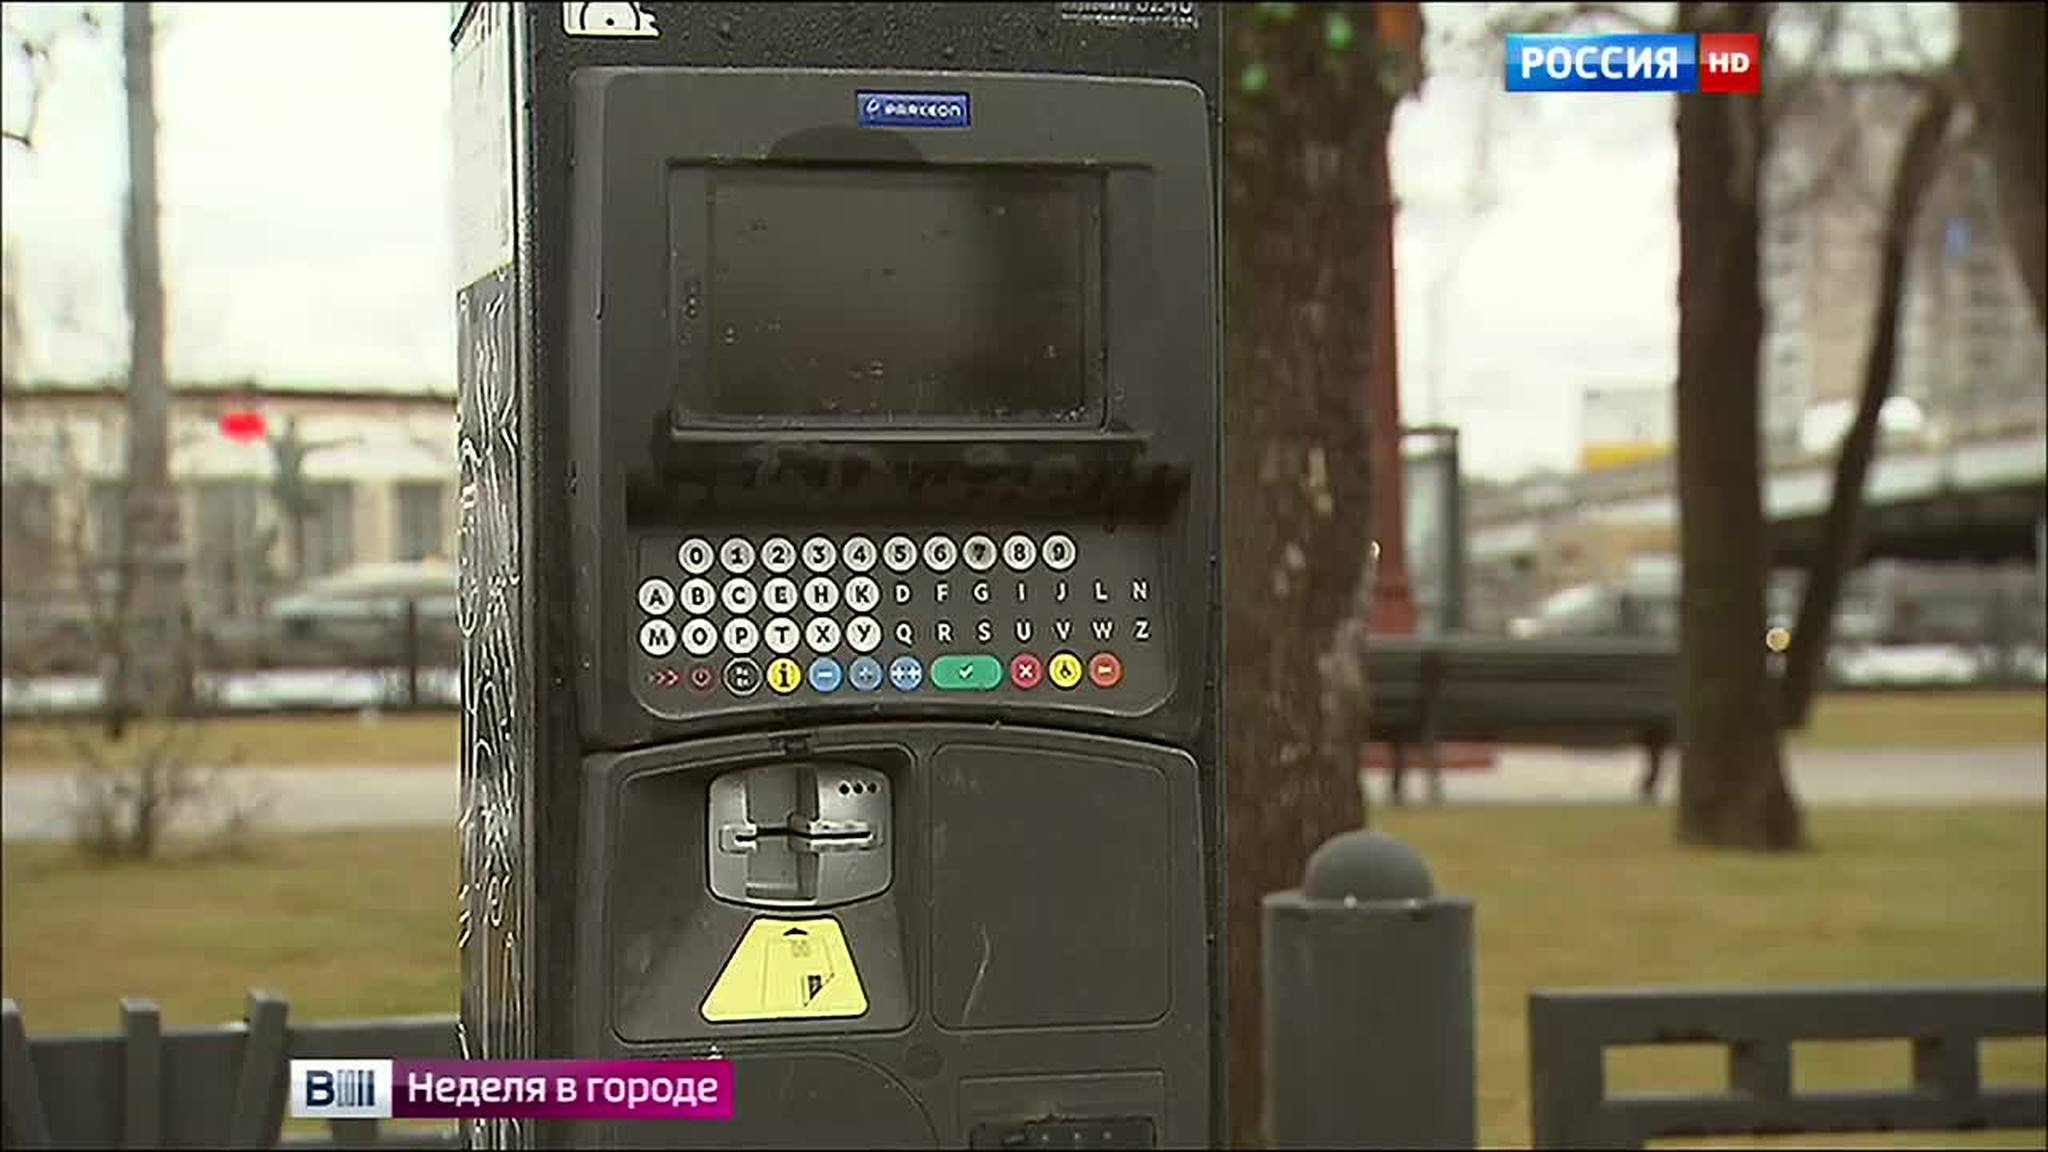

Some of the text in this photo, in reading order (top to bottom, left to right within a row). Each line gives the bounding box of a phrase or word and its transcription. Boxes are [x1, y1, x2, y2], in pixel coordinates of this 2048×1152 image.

[689, 542, 1066, 565] 0 1 2 3 4 5 6 7 8 9
[648, 588, 666, 606] A
[691, 586, 705, 606] B
[731, 586, 746, 605] C
[774, 585, 788, 604] E
[814, 585, 829, 604] H
[855, 584, 870, 604] K
[896, 584, 910, 602] D
[937, 583, 948, 602] F
[974, 583, 989, 602] G
[1095, 582, 1108, 600] L
[1133, 581, 1147, 600] N
[648, 620, 1149, 647] M O P T X Y Q R S U V W Z
